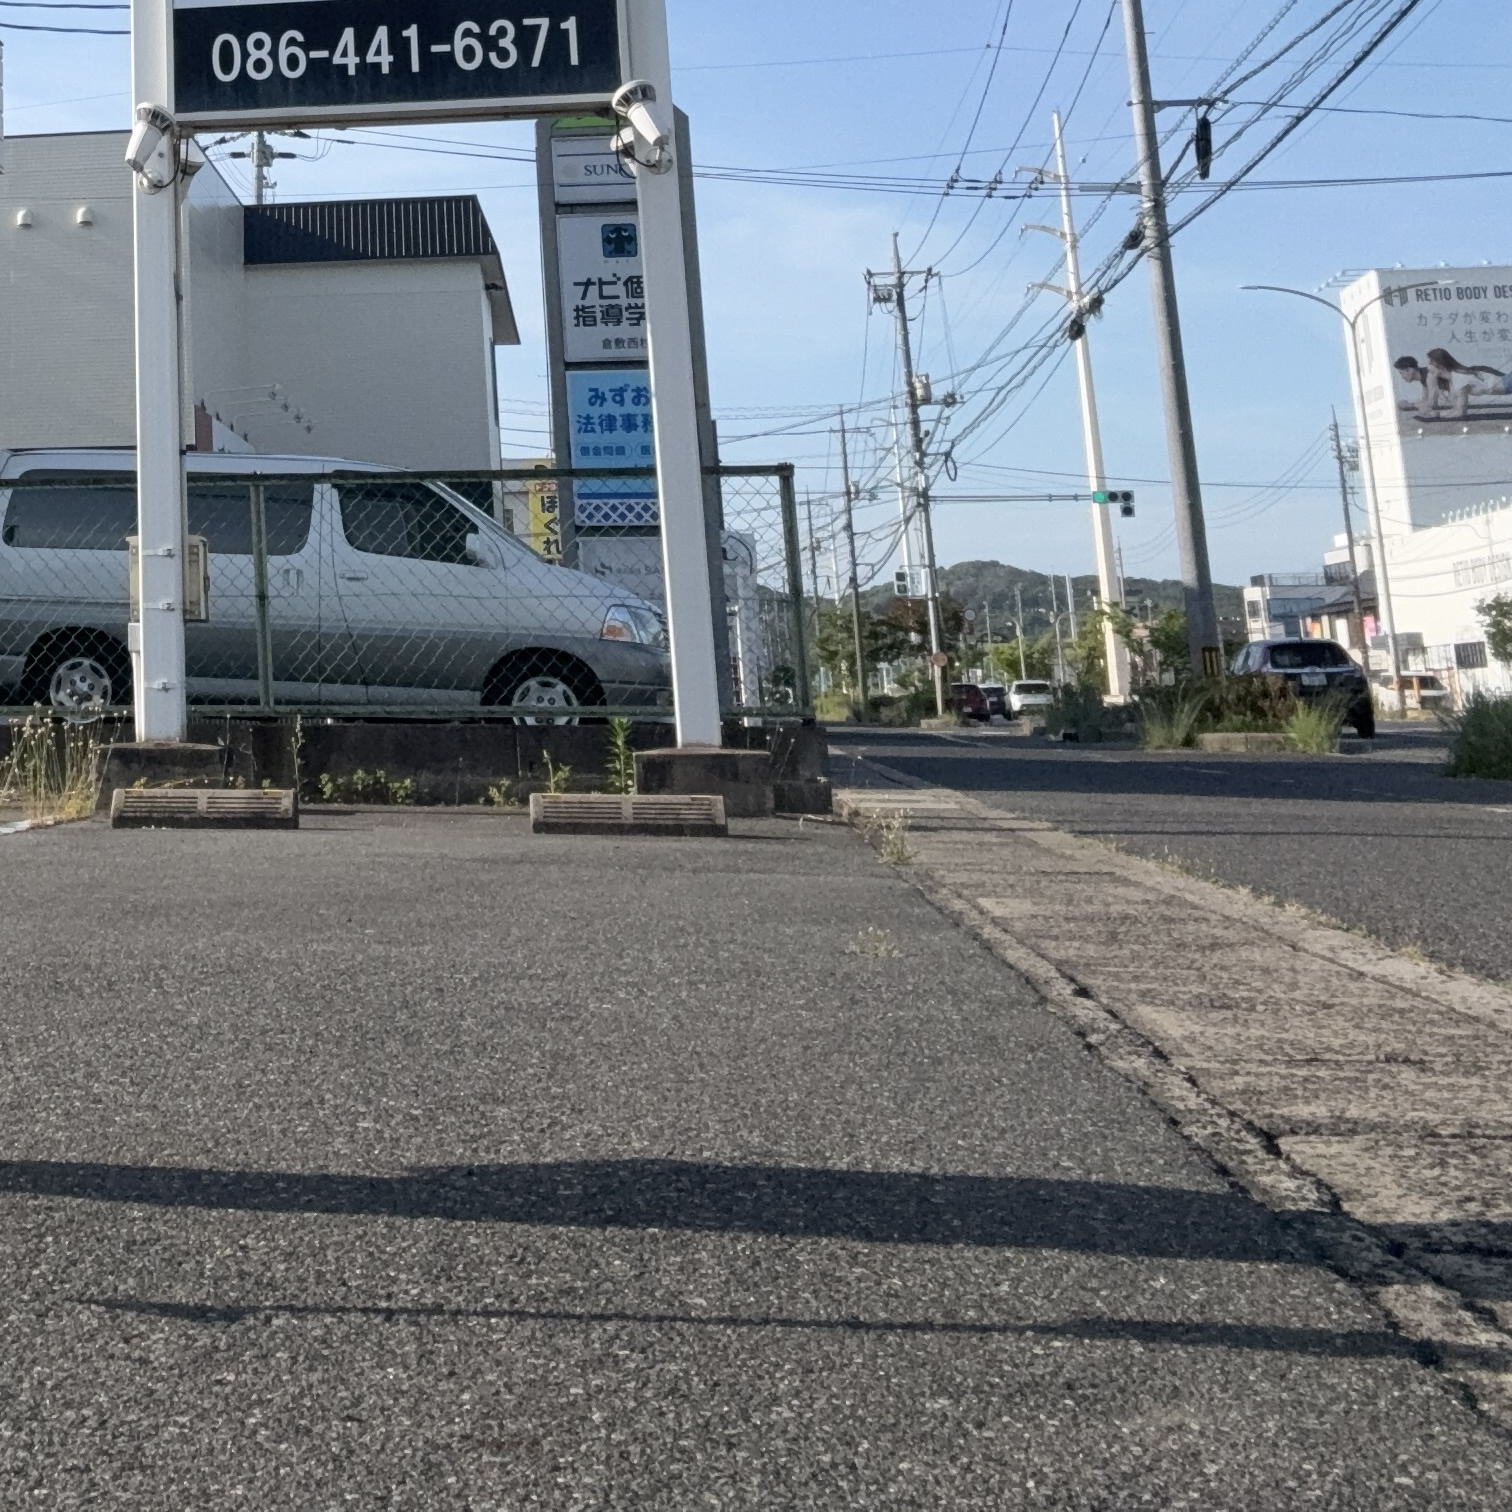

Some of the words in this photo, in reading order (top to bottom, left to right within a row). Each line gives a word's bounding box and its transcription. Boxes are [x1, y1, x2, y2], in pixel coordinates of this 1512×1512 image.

[211, 15, 580, 83] 086-441-6371
[1415, 287, 1452, 303] RETIO
[1456, 285, 1489, 301] BODY
